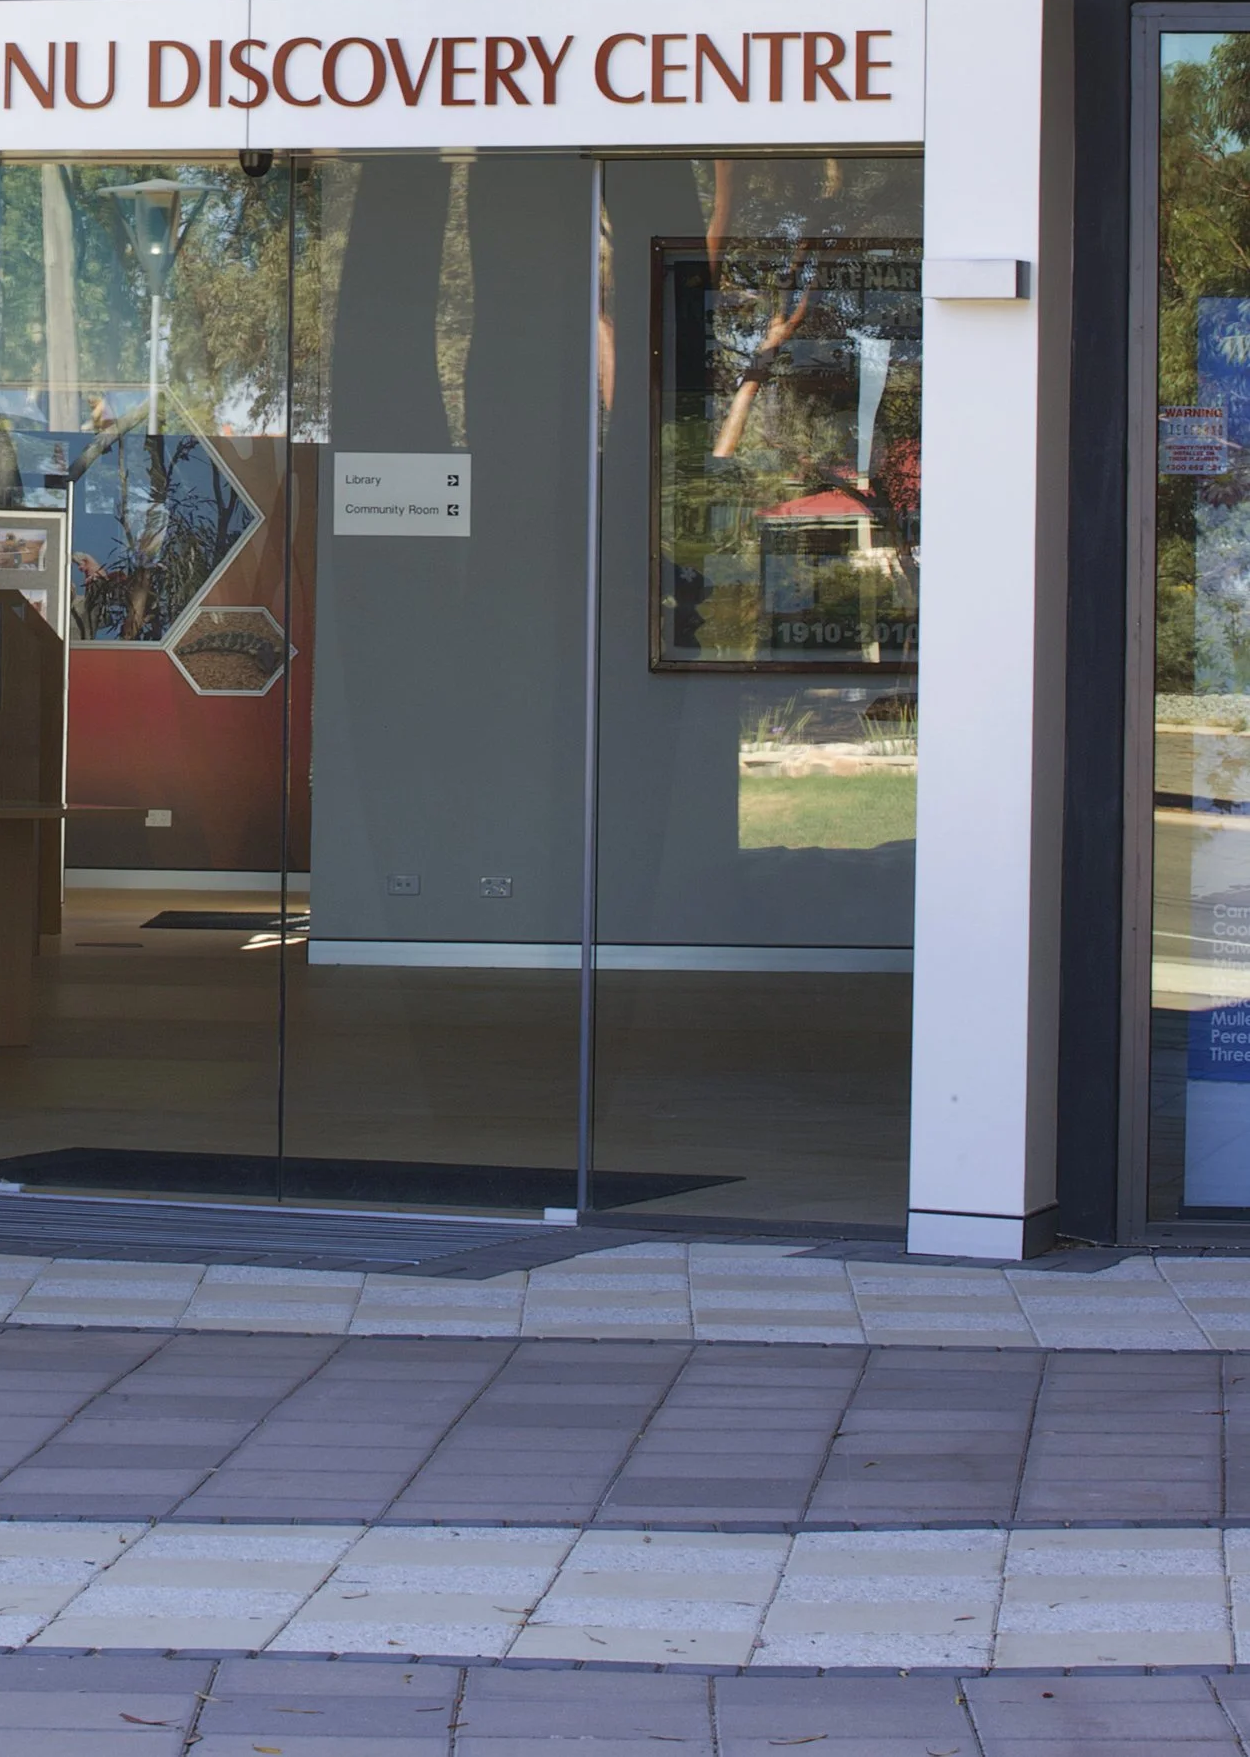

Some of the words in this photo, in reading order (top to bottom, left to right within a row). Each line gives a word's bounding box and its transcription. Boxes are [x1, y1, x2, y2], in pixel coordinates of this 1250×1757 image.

[148, 36, 574, 110] DISCOVERY
[594, 30, 893, 105] CENTRE
[1165, 408, 1223, 417] WARNING
[345, 475, 381, 487] Library
[345, 504, 405, 517] Community
[408, 505, 439, 515] Room
